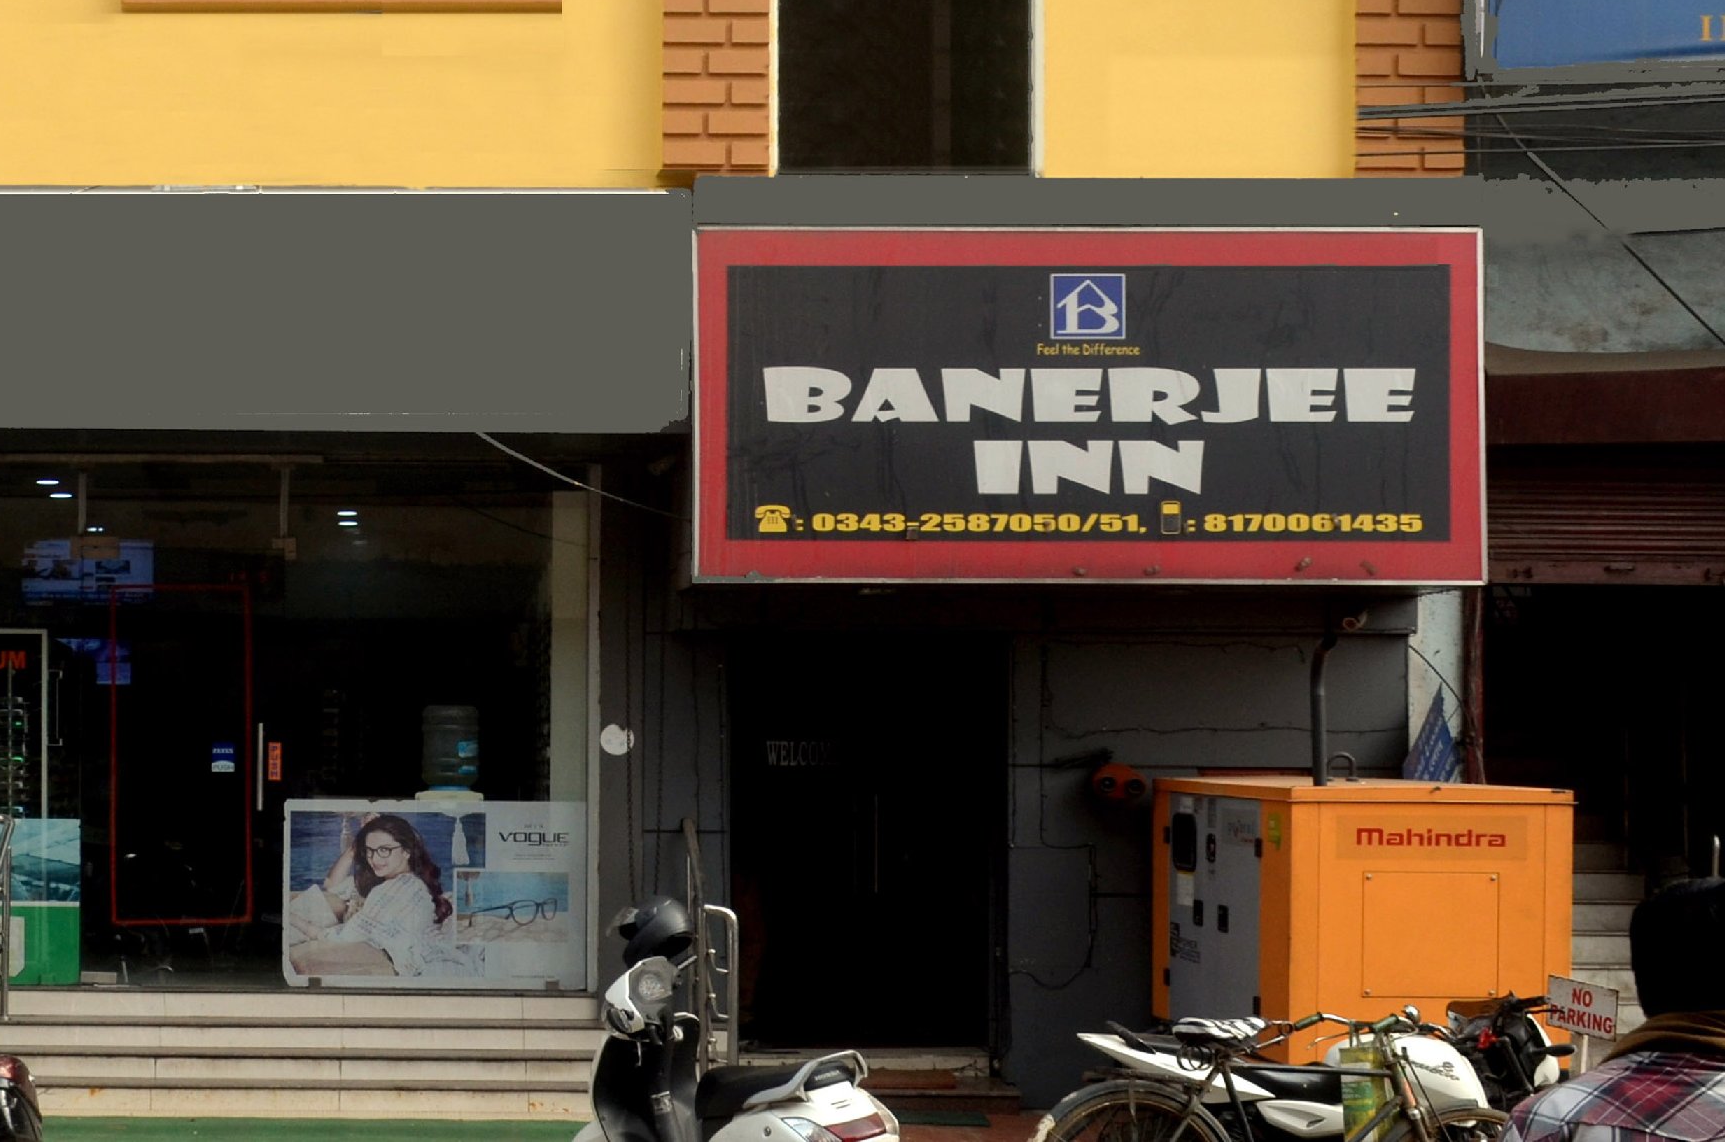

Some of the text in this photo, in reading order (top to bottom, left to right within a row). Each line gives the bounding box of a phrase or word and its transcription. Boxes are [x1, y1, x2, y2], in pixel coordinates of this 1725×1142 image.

[1037, 343, 1141, 356] Feel the Difference
[763, 366, 1416, 425] BANERJEE
[973, 440, 1205, 495] INN
[1204, 513, 1424, 534] 8170061435
[1356, 827, 1506, 848] Mahindra
[1572, 987, 1593, 1008] NO
[1550, 1003, 1613, 1034] PARKING
